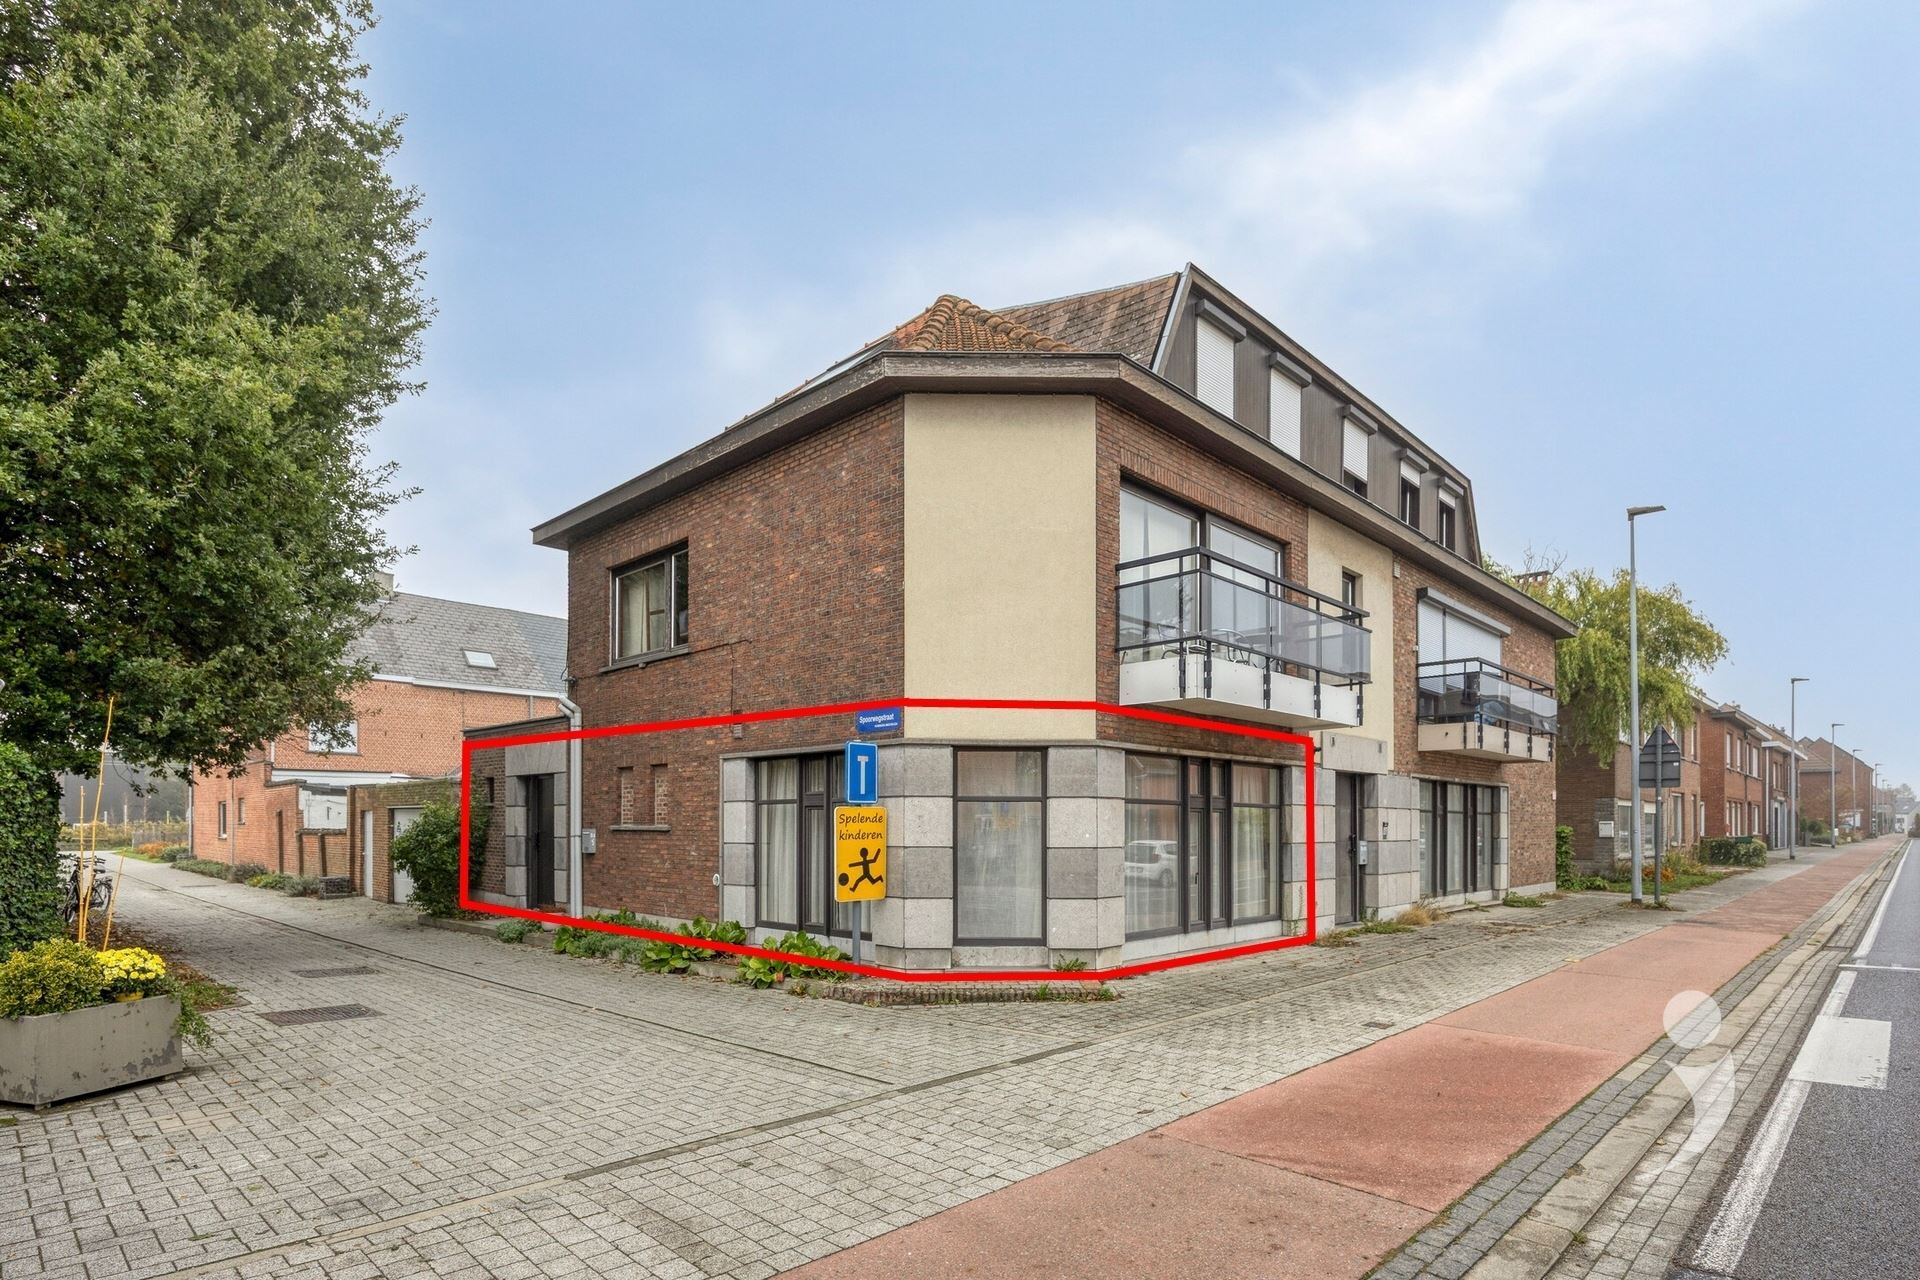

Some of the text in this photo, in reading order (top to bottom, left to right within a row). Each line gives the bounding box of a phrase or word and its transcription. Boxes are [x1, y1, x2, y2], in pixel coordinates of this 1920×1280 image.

[859, 713, 895, 724] Spoorwegstraat
[839, 812, 884, 828] Spelende
[839, 829, 883, 841] kinderen
